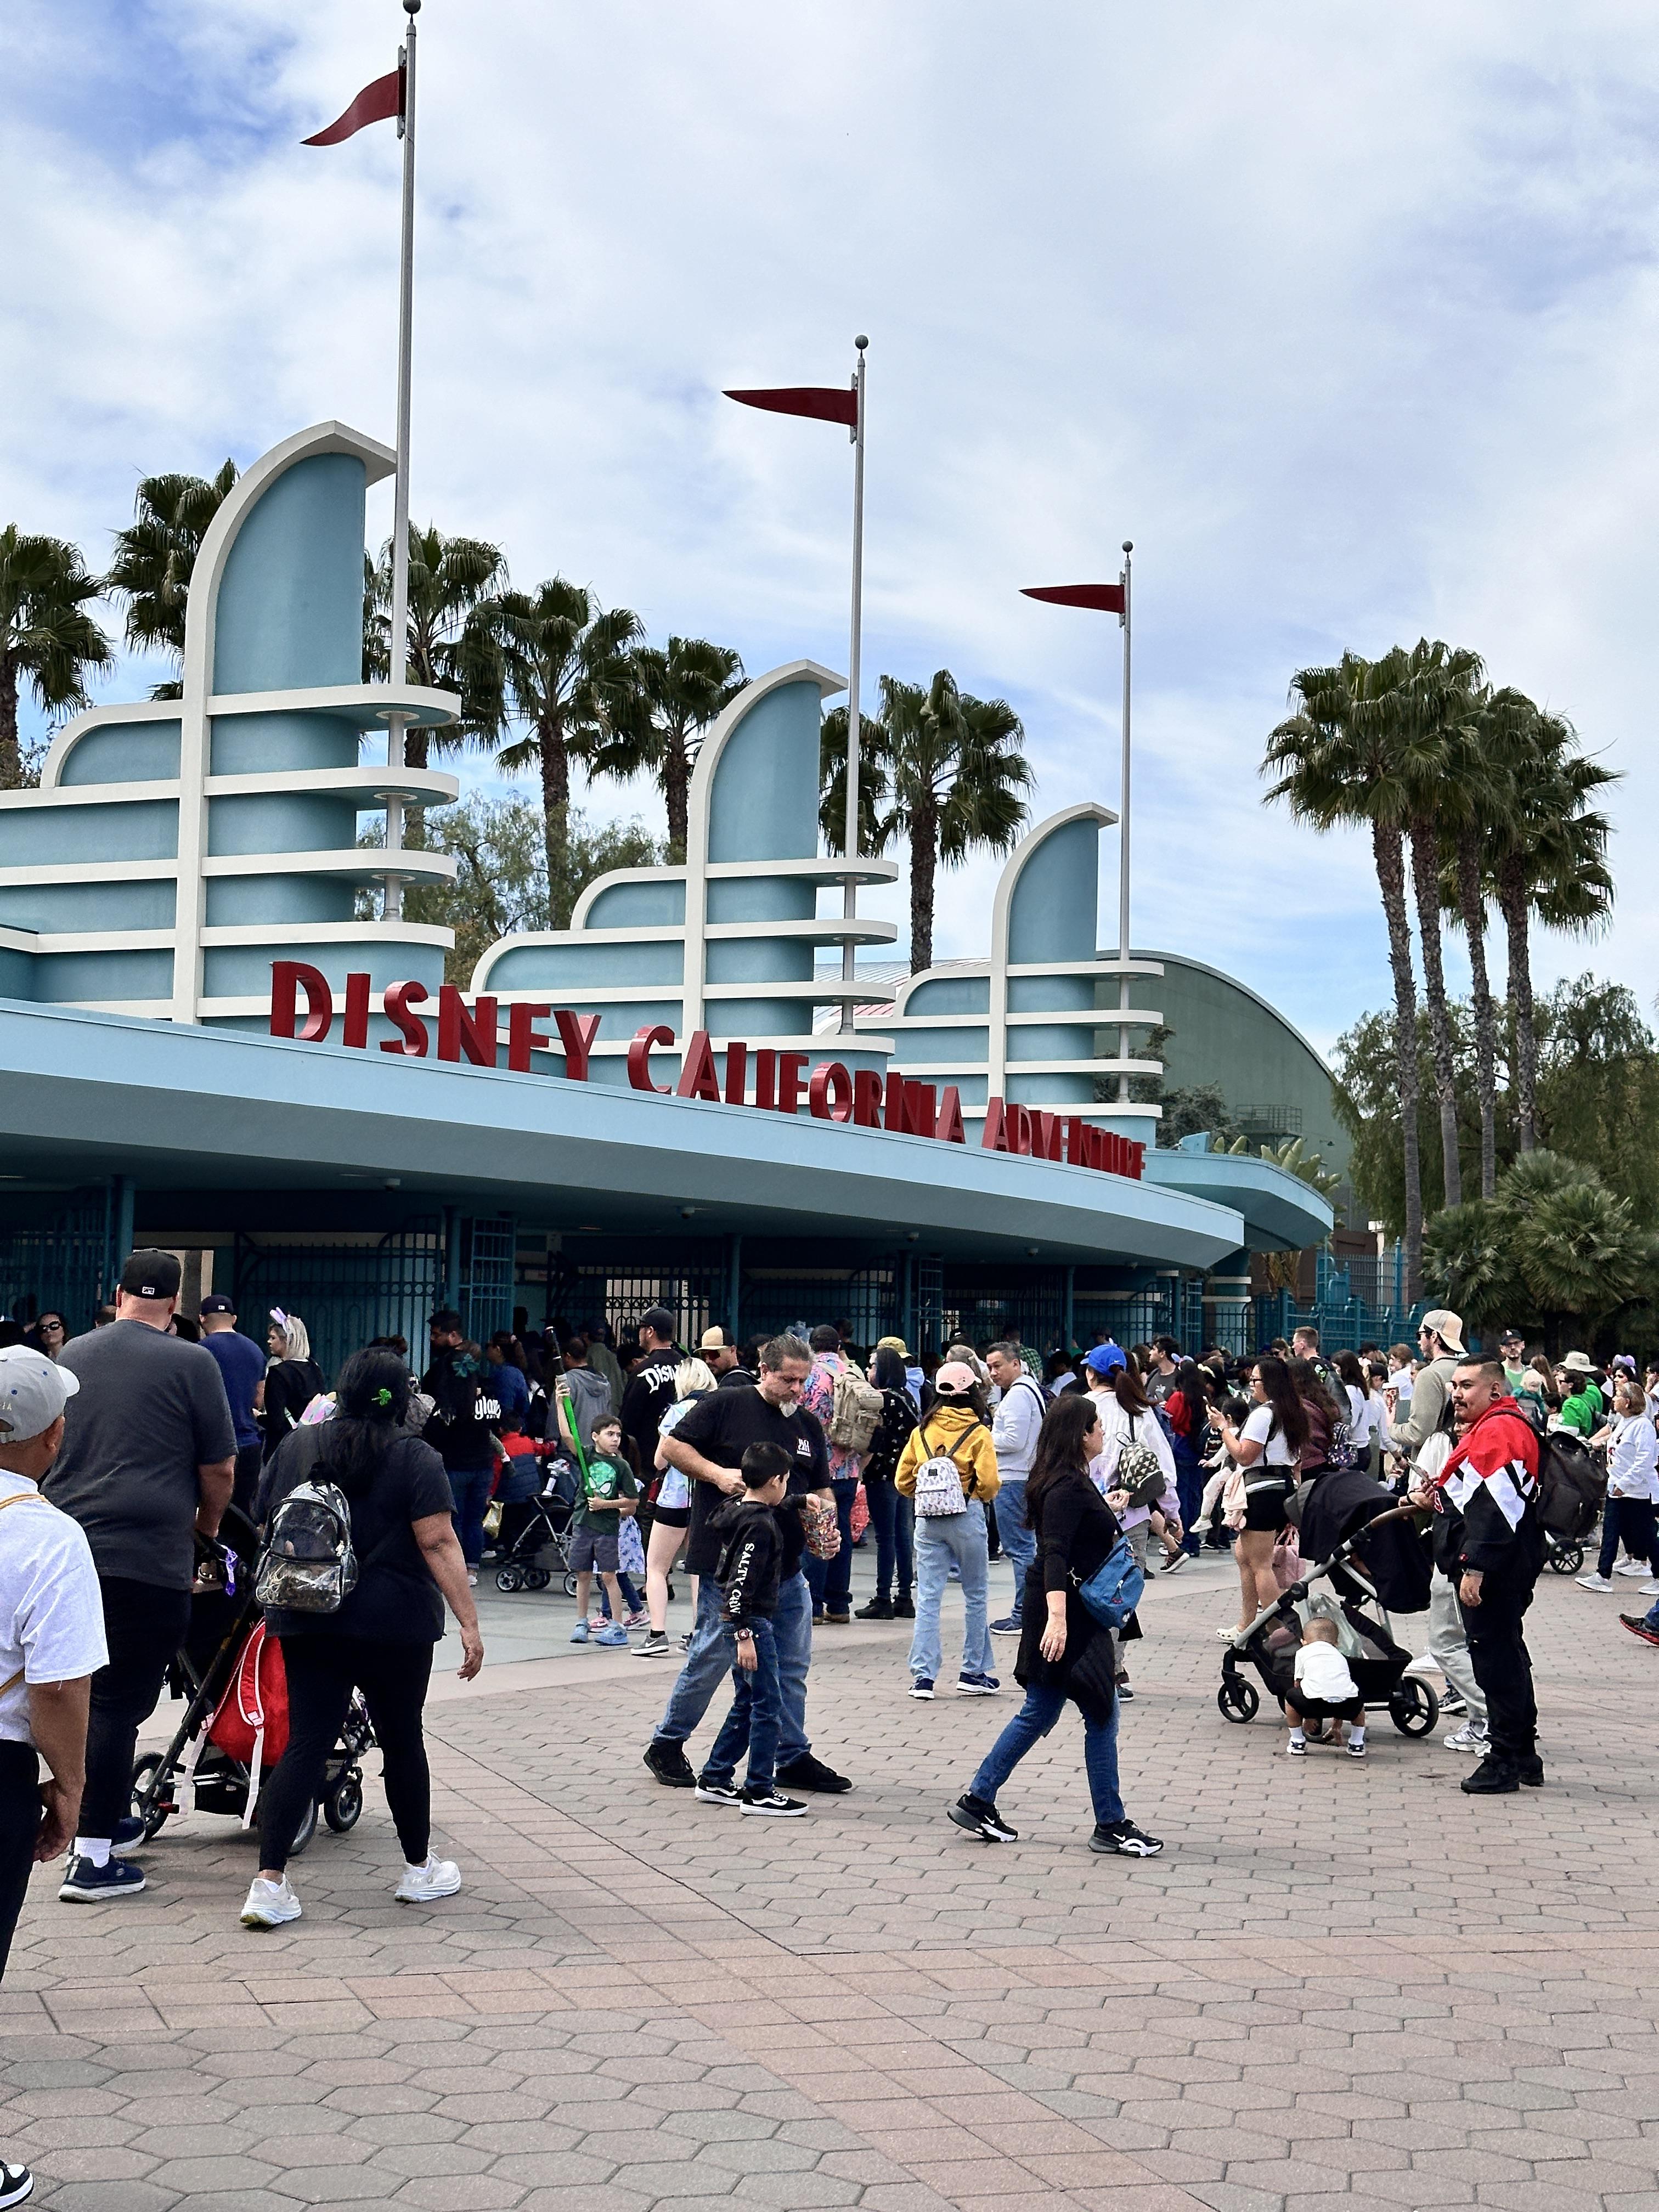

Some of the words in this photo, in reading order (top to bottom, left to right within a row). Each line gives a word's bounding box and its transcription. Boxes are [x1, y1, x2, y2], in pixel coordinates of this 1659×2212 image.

[272, 962, 601, 1080] DISNEY
[628, 1025, 966, 1144] CALIFORNIA
[982, 1097, 1147, 1181] ADVENTURE
[735, 1542, 755, 1586] SALTY
